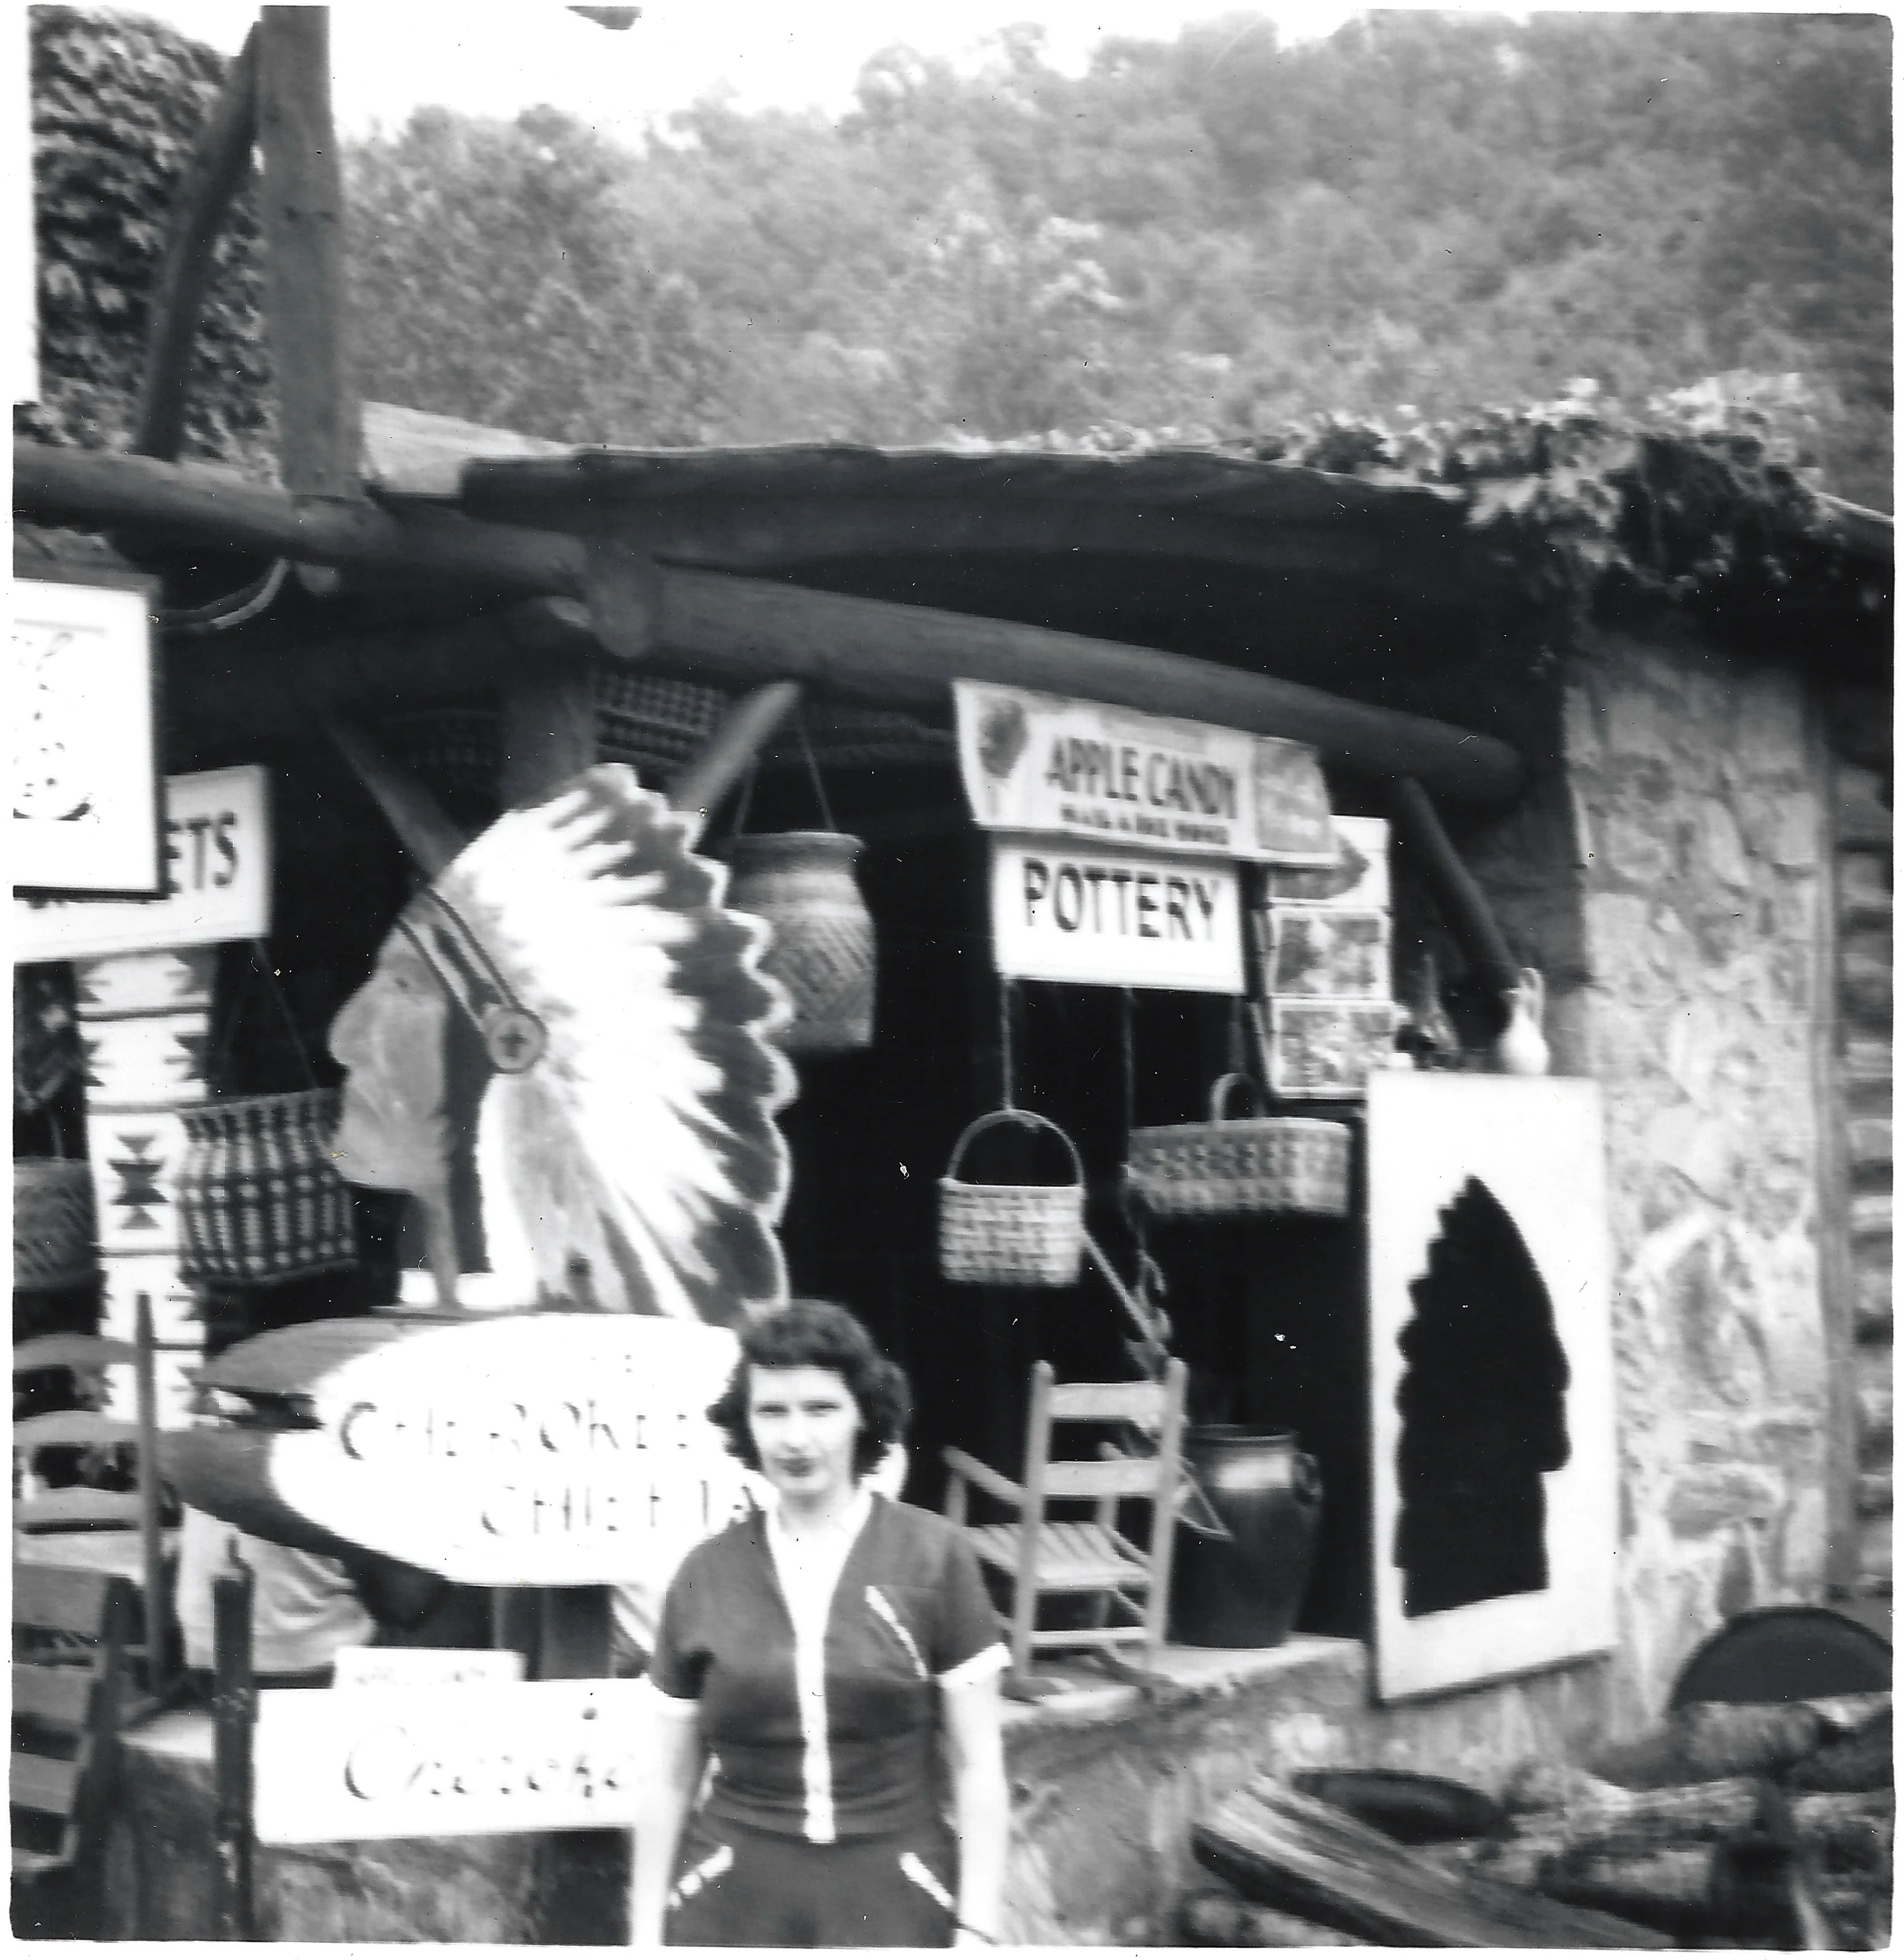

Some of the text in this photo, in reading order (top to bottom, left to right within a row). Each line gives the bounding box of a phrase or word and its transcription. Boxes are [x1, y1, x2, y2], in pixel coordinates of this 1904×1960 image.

[1046, 737, 1237, 820] APPLE CANDY
[163, 812, 238, 892] ETS
[1023, 857, 1221, 940] POTTERY
